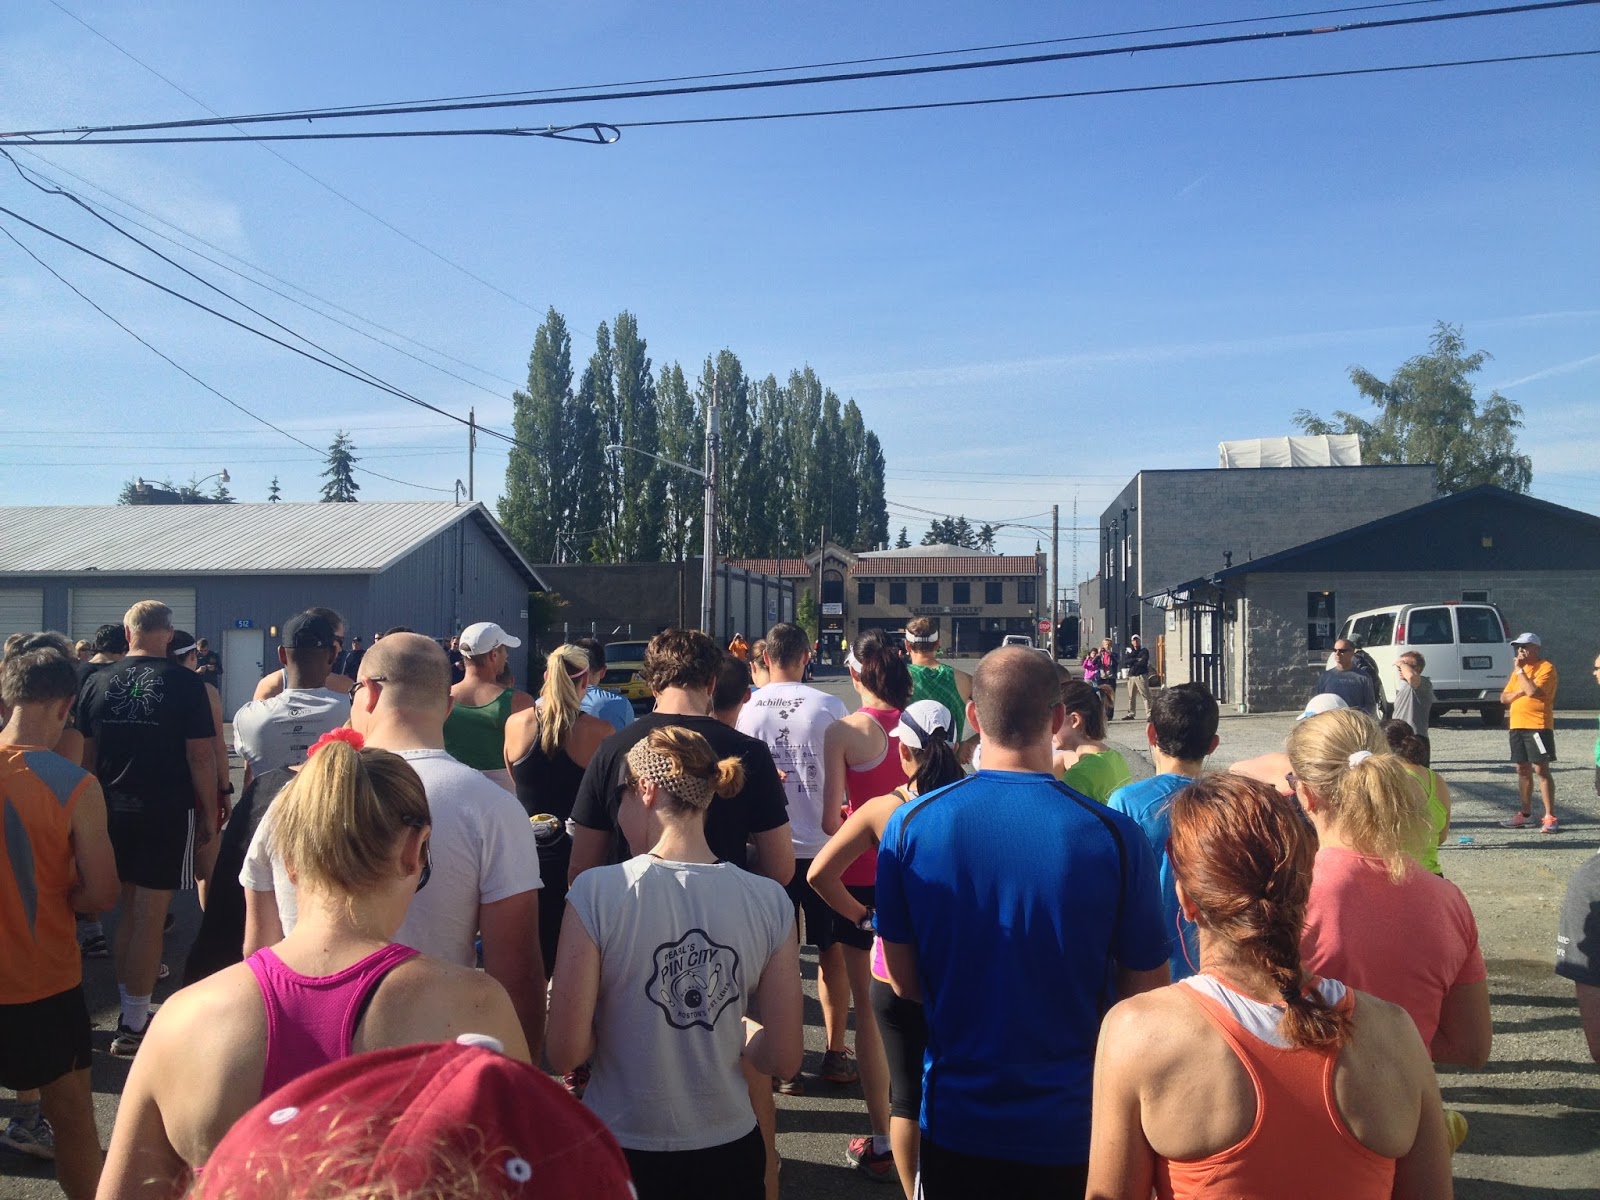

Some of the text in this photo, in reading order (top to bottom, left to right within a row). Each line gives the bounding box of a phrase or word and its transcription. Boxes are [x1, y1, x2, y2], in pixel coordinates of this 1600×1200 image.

[238, 620, 250, 628] 512
[755, 698, 792, 707] Achilles
[664, 943, 696, 962] PEARL'S
[661, 949, 718, 985] PIN CITY
